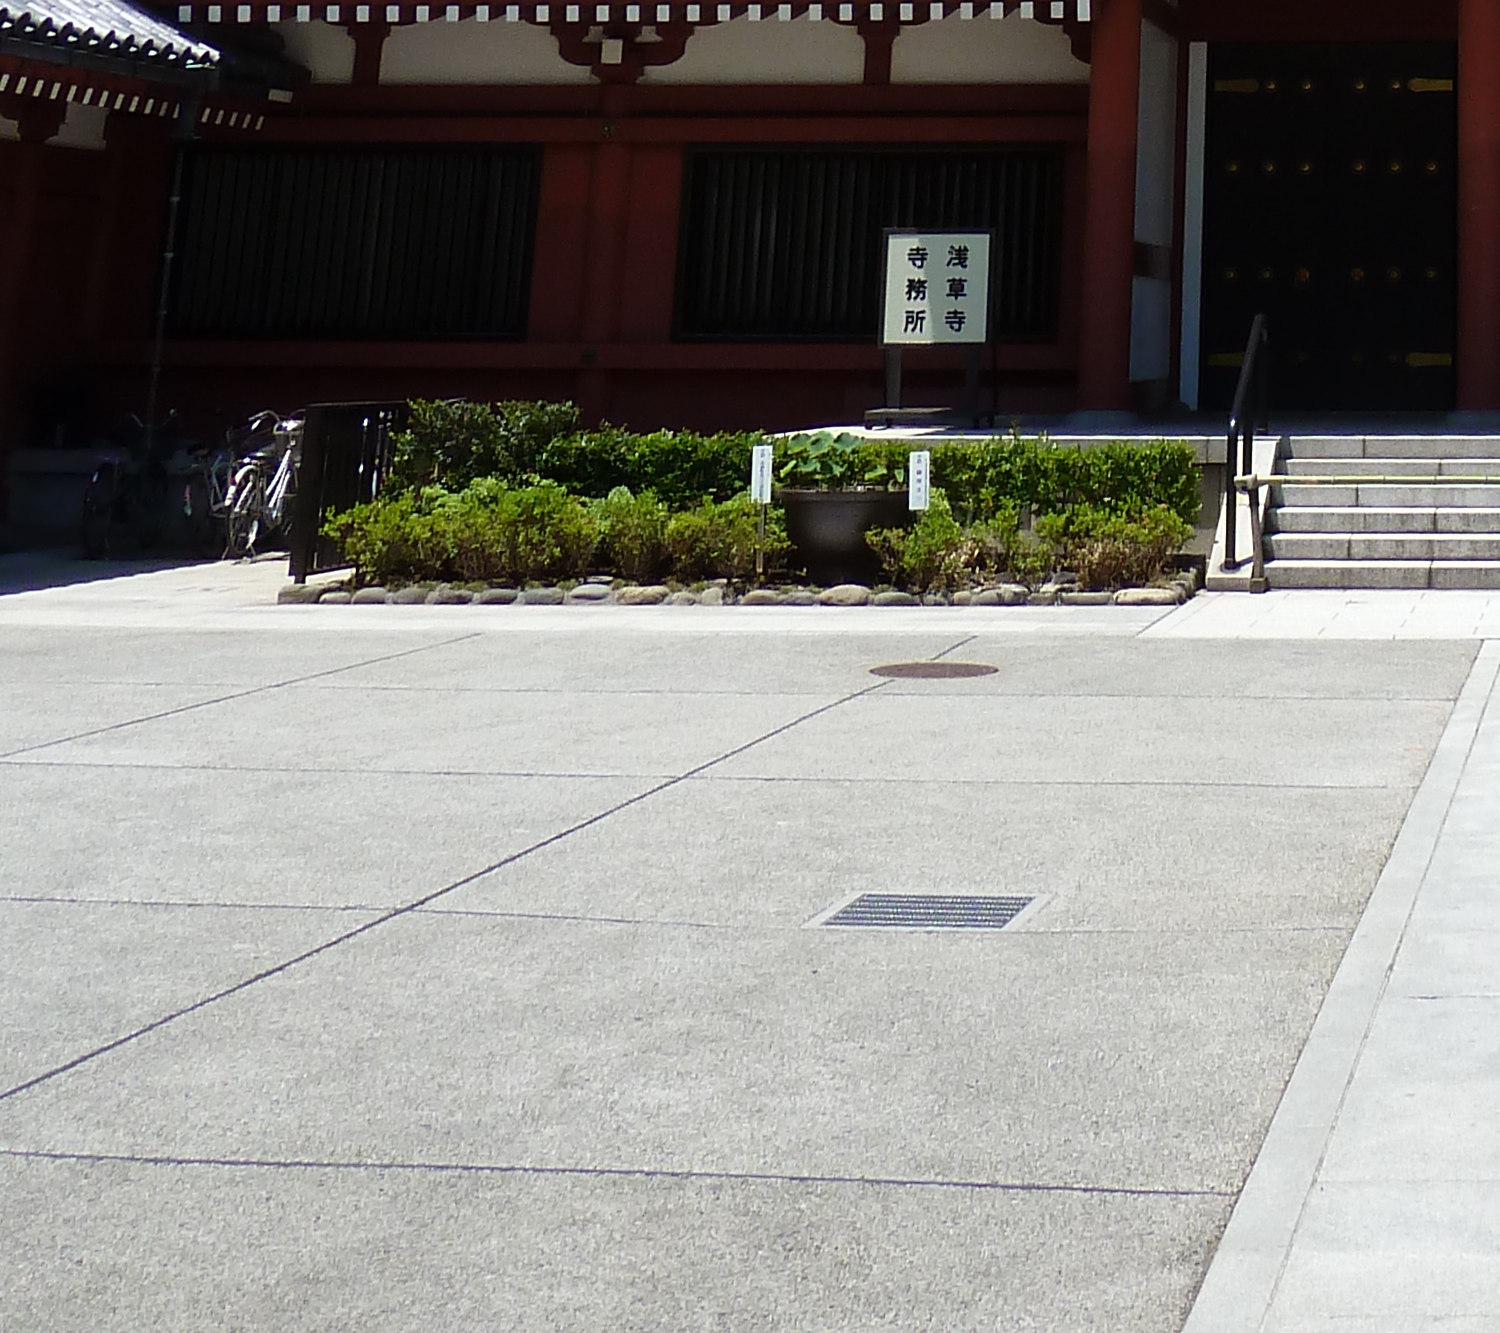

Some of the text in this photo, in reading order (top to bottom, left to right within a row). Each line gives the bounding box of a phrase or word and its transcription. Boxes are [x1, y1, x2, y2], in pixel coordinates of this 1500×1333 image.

[903, 246, 928, 333] 寺務所
[944, 245, 969, 333] 浅草寺
